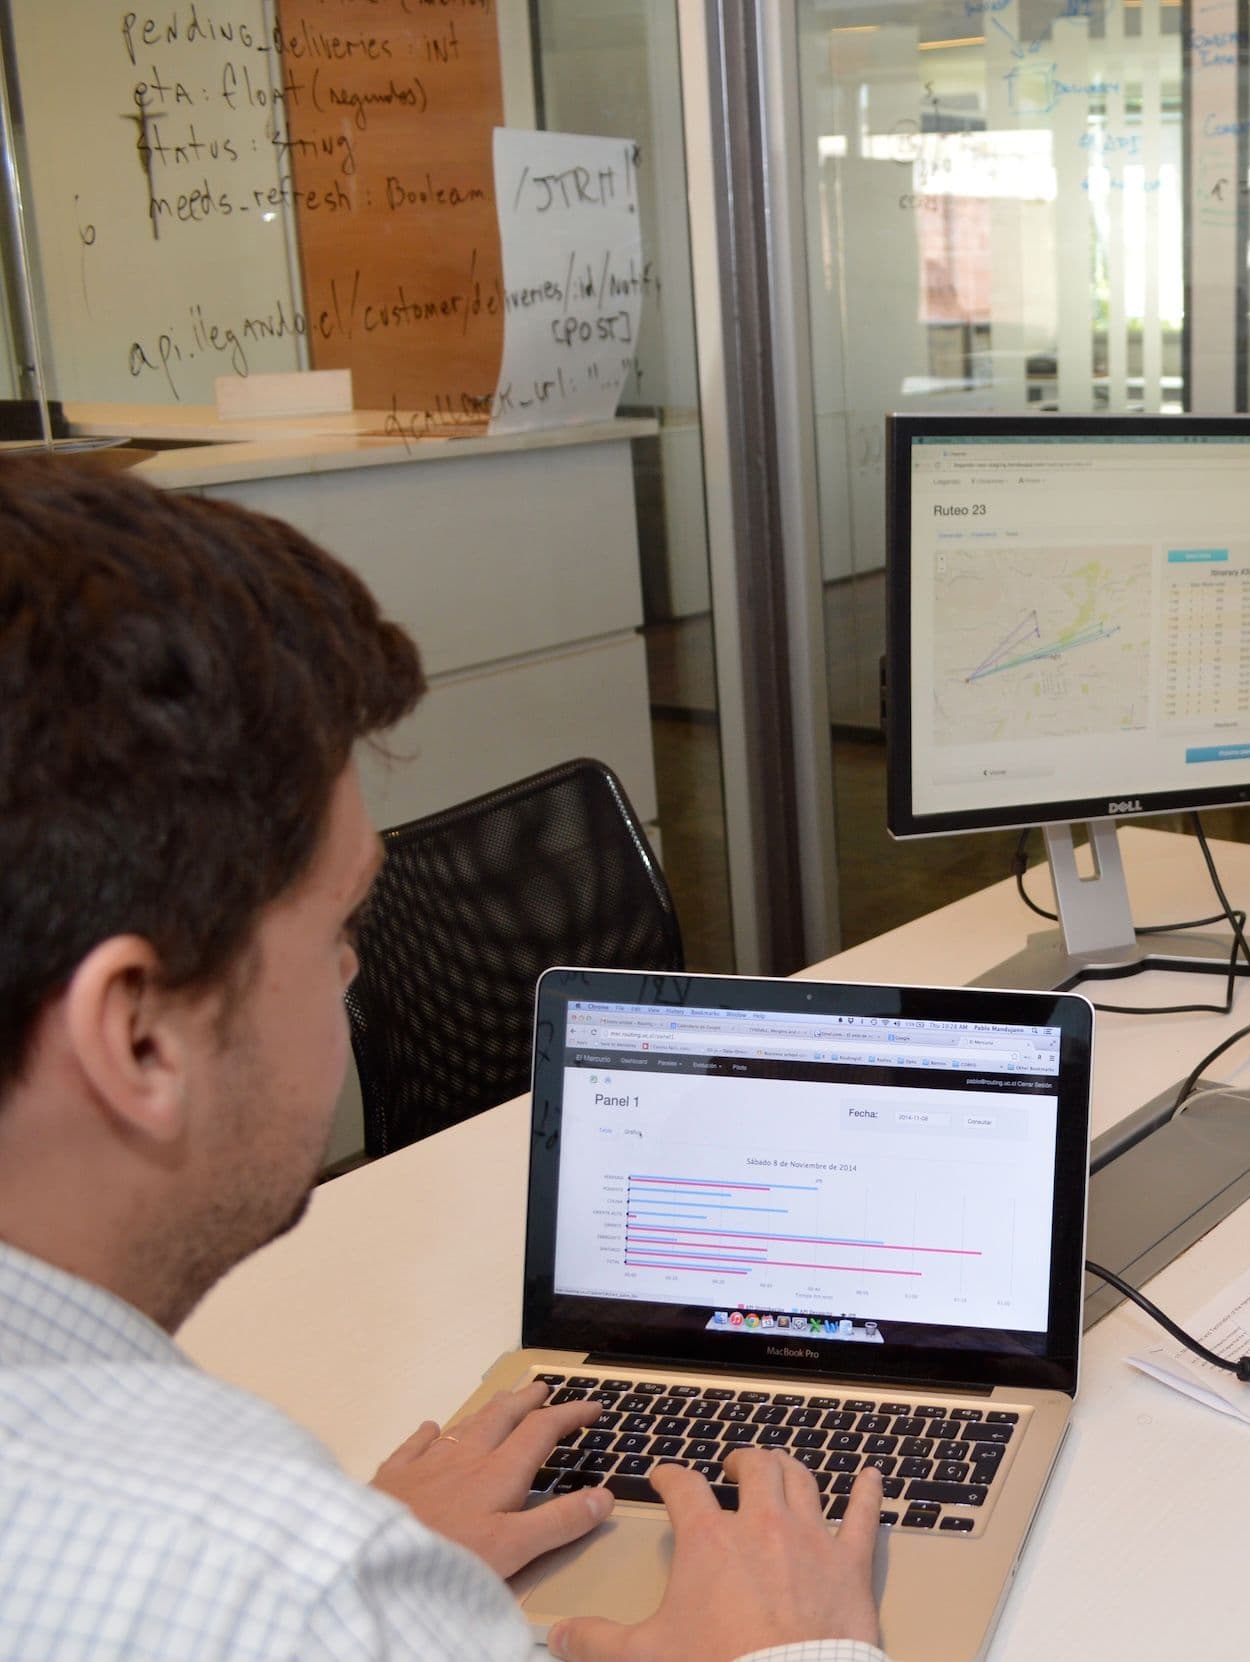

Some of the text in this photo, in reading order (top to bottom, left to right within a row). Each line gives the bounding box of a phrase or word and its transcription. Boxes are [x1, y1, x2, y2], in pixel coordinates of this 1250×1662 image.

[933, 504, 987, 517] Ruteo 23
[1108, 799, 1143, 815] DELL
[594, 1093, 640, 1108] Panel 1
[848, 1108, 879, 1119] Fecha:
[790, 1161, 827, 1171] Noviembre
[828, 1163, 838, 1171] de
[839, 1164, 857, 1173] 2014
[767, 1345, 820, 1360] MacBook Pro
